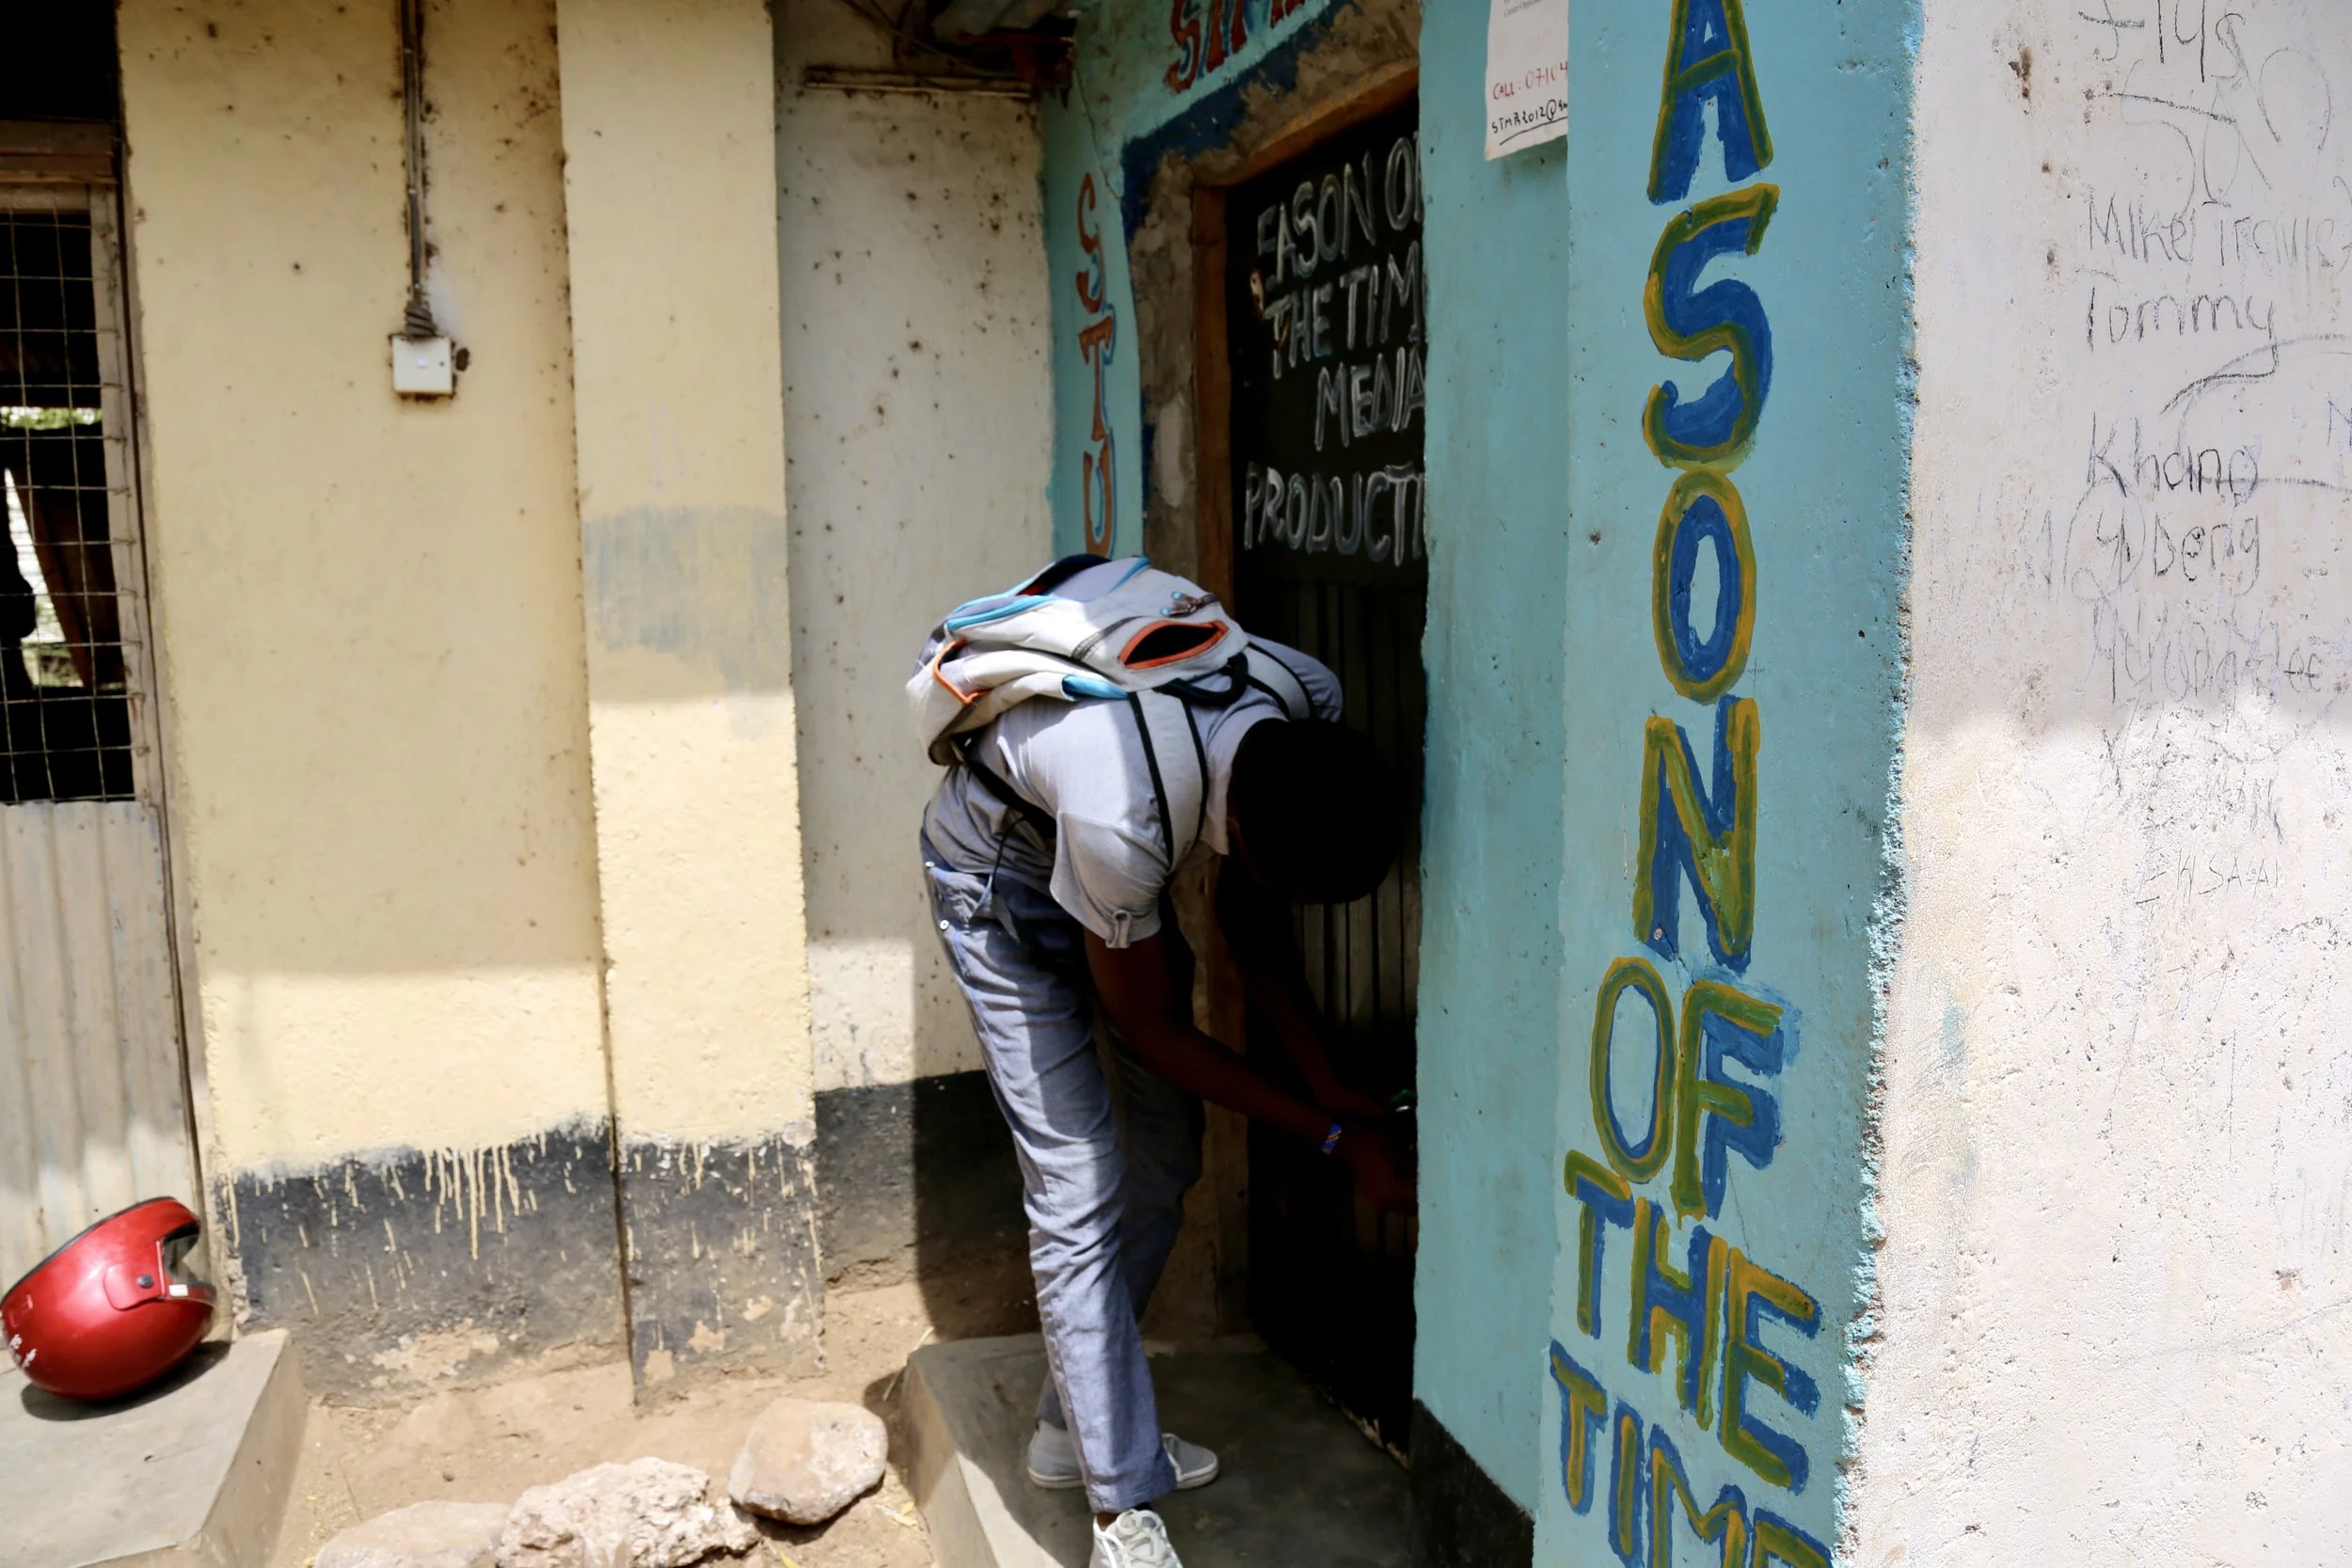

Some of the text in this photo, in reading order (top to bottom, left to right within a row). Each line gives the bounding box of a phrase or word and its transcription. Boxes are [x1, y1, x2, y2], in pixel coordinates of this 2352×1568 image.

[1263, 240, 1425, 380] THE TIM
[1314, 344, 1425, 451] MEDIA
[1244, 461, 1425, 567] PRODUCTI
[1590, 957, 1792, 1227] OF
[1565, 1149, 1820, 1496] THE
